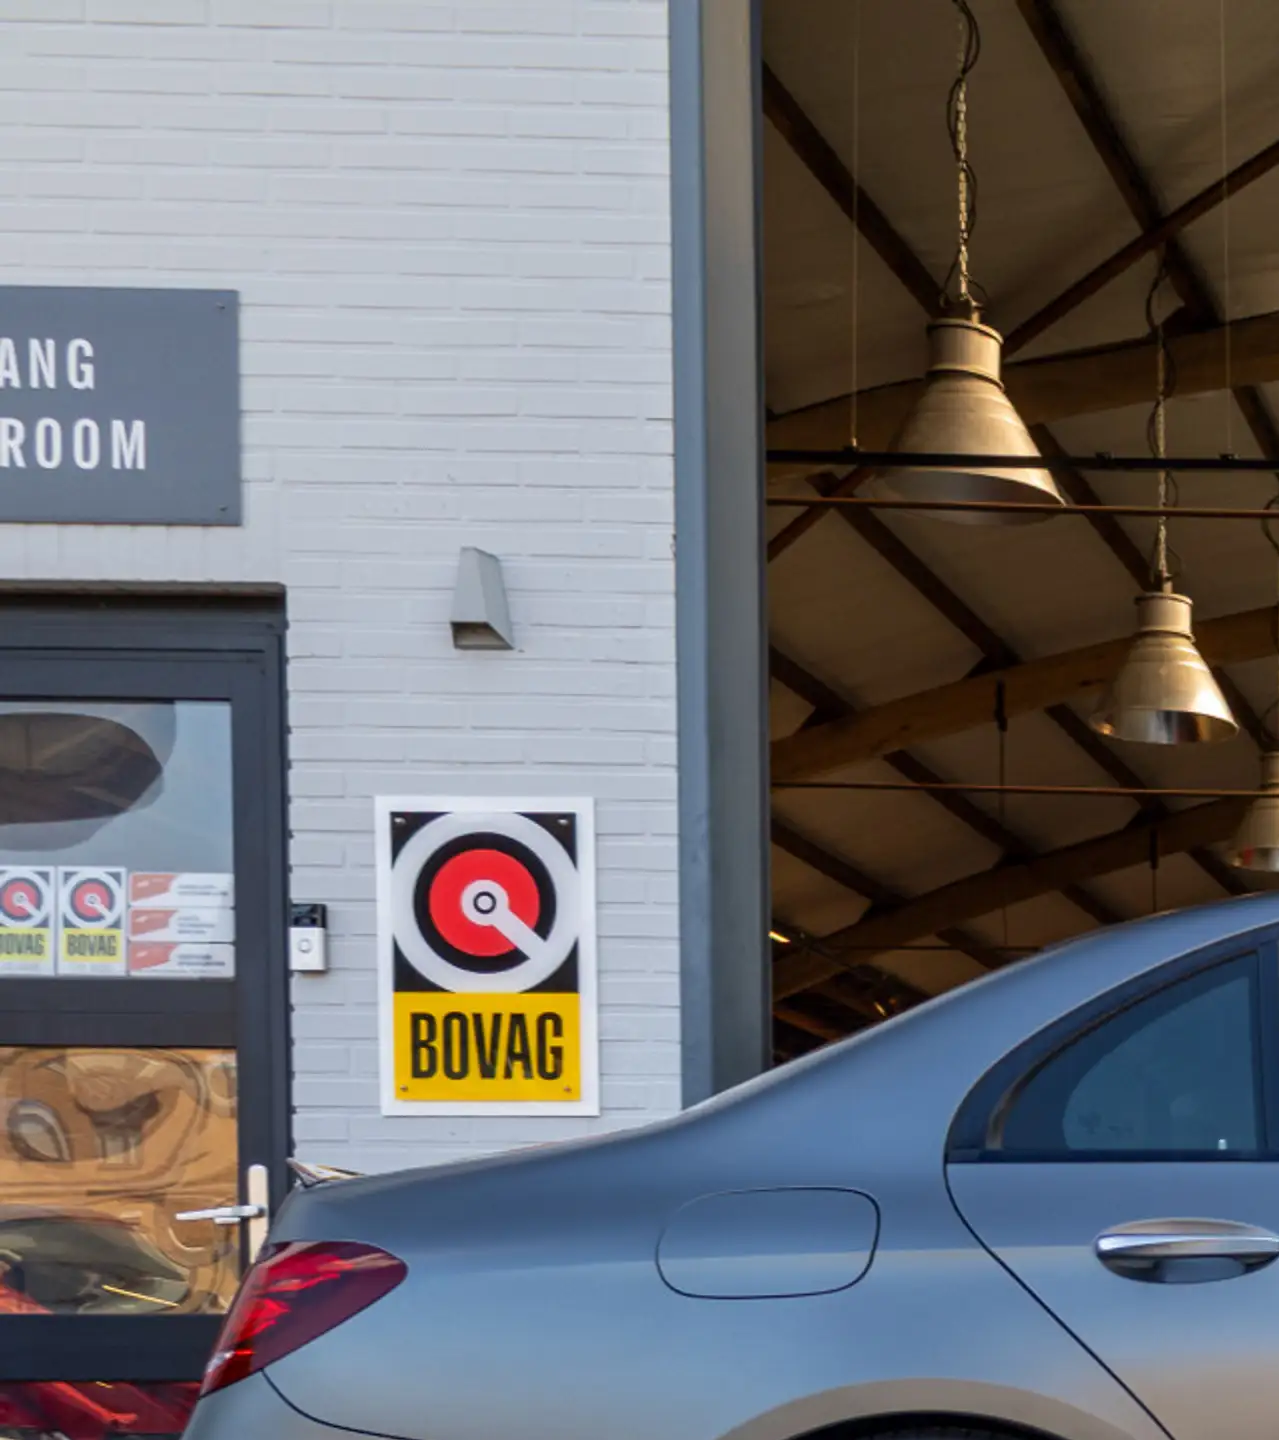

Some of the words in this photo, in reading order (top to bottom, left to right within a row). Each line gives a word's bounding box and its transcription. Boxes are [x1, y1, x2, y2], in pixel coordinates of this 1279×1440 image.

[0, 338, 95, 390] ANG
[0, 417, 146, 470] ROOM
[67, 934, 117, 957] BOVAG
[411, 1012, 563, 1080] BOVAG
